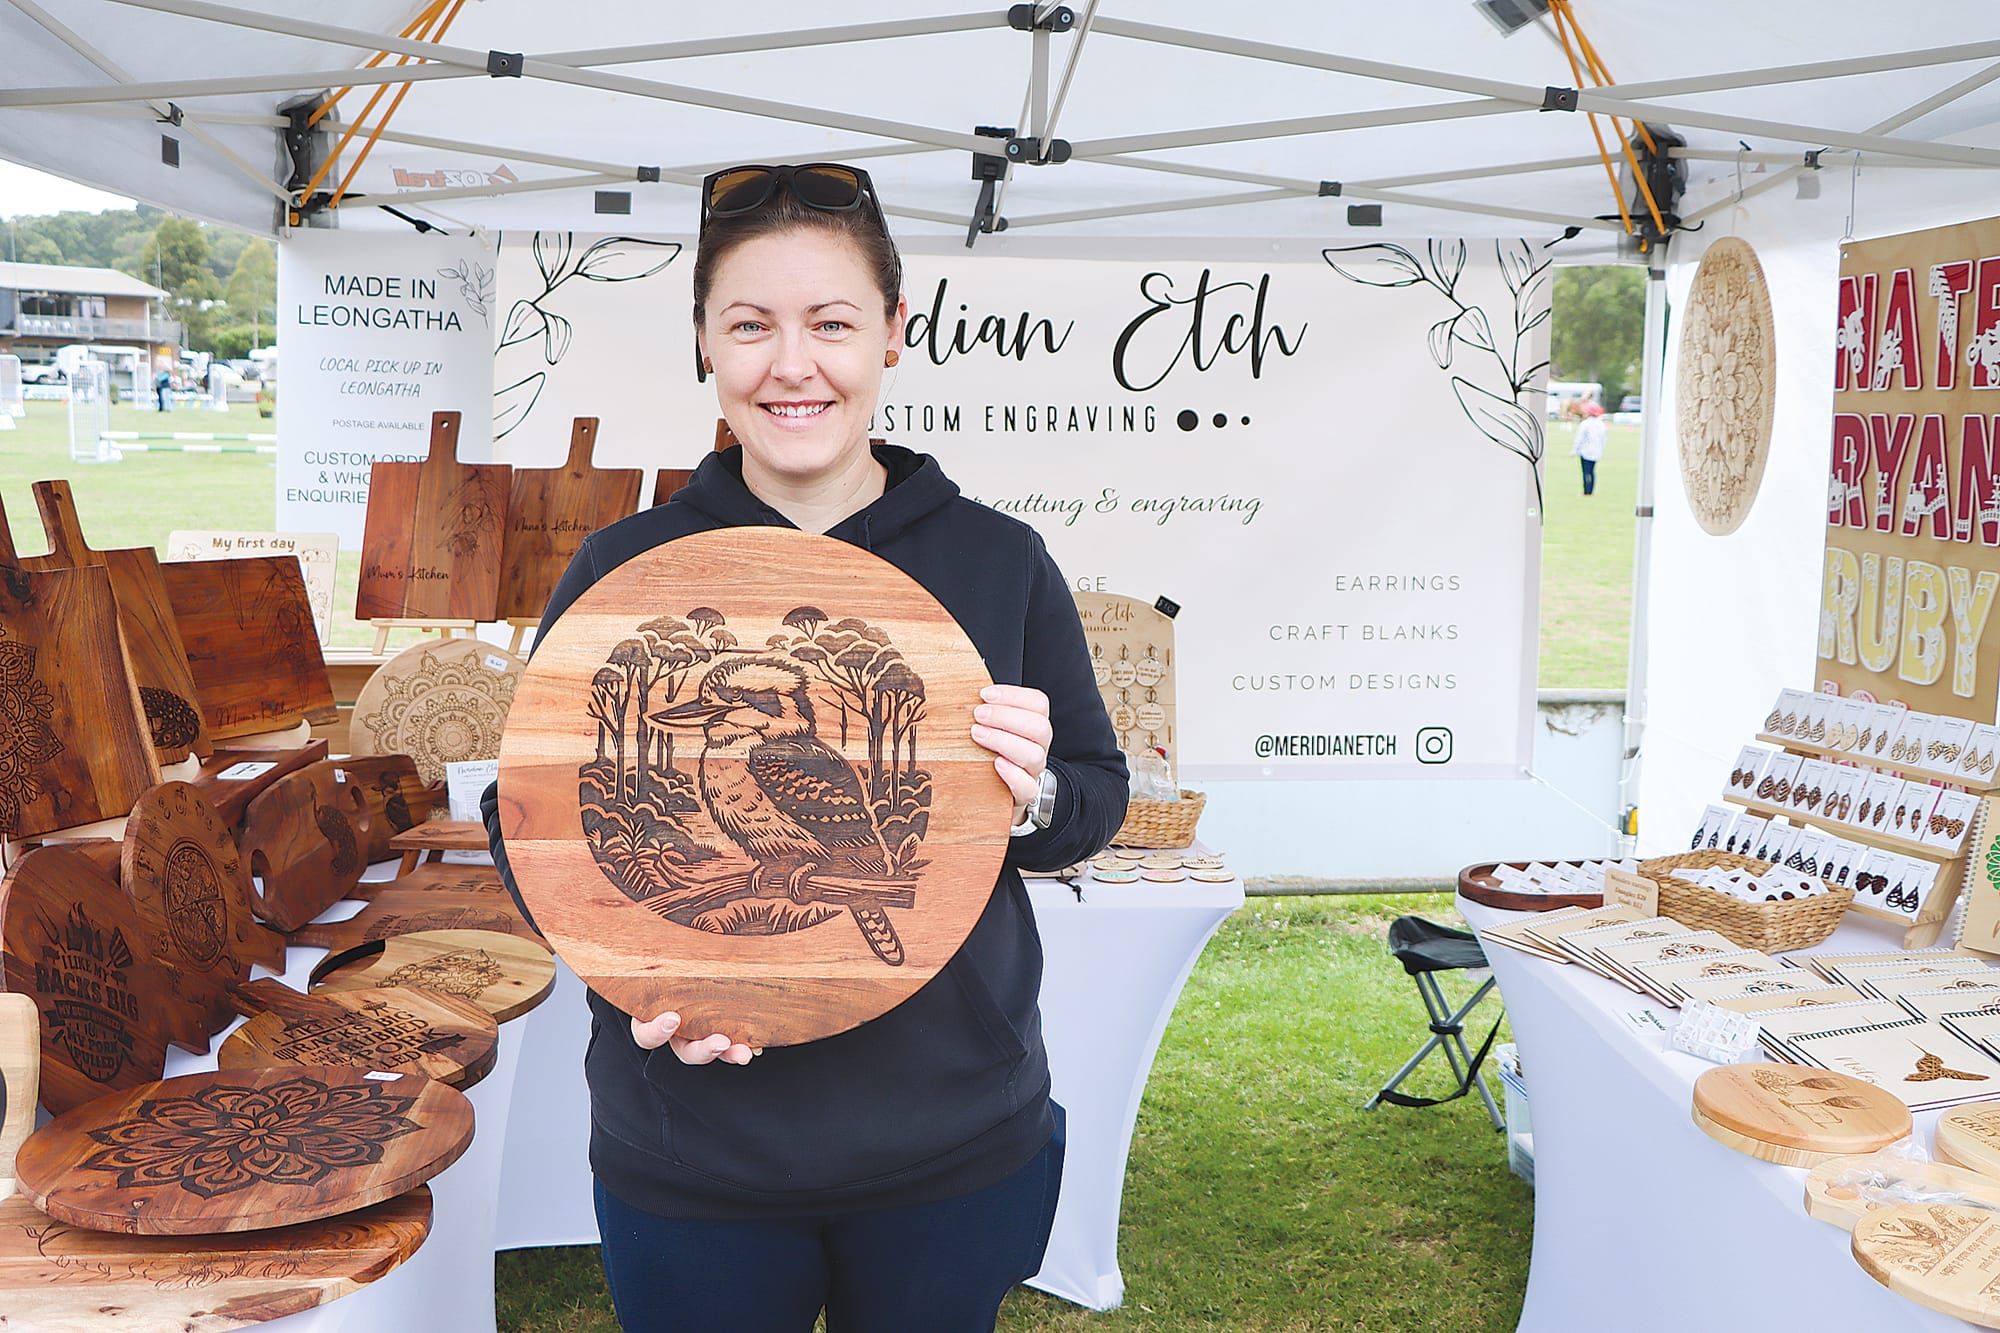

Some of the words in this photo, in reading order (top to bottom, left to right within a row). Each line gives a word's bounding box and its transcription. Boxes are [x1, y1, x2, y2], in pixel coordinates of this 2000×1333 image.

[324, 274, 402, 299] MADE
[411, 278, 437, 300] IN
[298, 304, 463, 332] LEONGATHA
[904, 278, 1075, 366] dian
[1112, 268, 1309, 393] Etch
[1835, 258, 2000, 392] NATE
[319, 356, 360, 373] LOCAL
[365, 358, 400, 375] PICK
[402, 361, 422, 375] UP
[423, 361, 444, 376] IN
[340, 380, 422, 398] LEONGATHA
[332, 419, 376, 429] POSTAGE
[377, 421, 425, 431] AVAILABLE
[868, 404, 963, 433] STOM
[984, 405, 1157, 433] ENGRAVING
[304, 451, 376, 466] CUSTOM
[318, 471, 329, 484] &
[1828, 413, 2000, 548] RYAN
[286, 488, 368, 505] ENQUIRIE
[992, 490, 1086, 527] cutting
[1095, 487, 1121, 514] &
[1131, 491, 1264, 526] engraving
[212, 537, 232, 552] My
[237, 537, 265, 548] first
[270, 538, 295, 553] day
[406, 565, 449, 582] Kitchen
[1336, 575, 1461, 592] EARRINGS
[1269, 624, 1350, 641] CRAFT
[1362, 624, 1460, 641] BLANKS
[1818, 546, 1999, 698] RUBY
[1232, 675, 1337, 692] CUSTOM
[1350, 673, 1458, 690] DESIGNS
[1255, 734, 1397, 758] @MERIDIANETCH
[68, 954, 92, 973] LIKE
[94, 961, 109, 983] MY
[36, 962, 102, 1003] RACKS
[105, 985, 140, 1021] BIG
[298, 1023, 373, 1053] RACKS
[374, 1011, 415, 1028] BIG
[339, 1019, 430, 1054] RUBBED
[353, 1028, 450, 1061] PORK
[380, 1050, 423, 1069] LED
